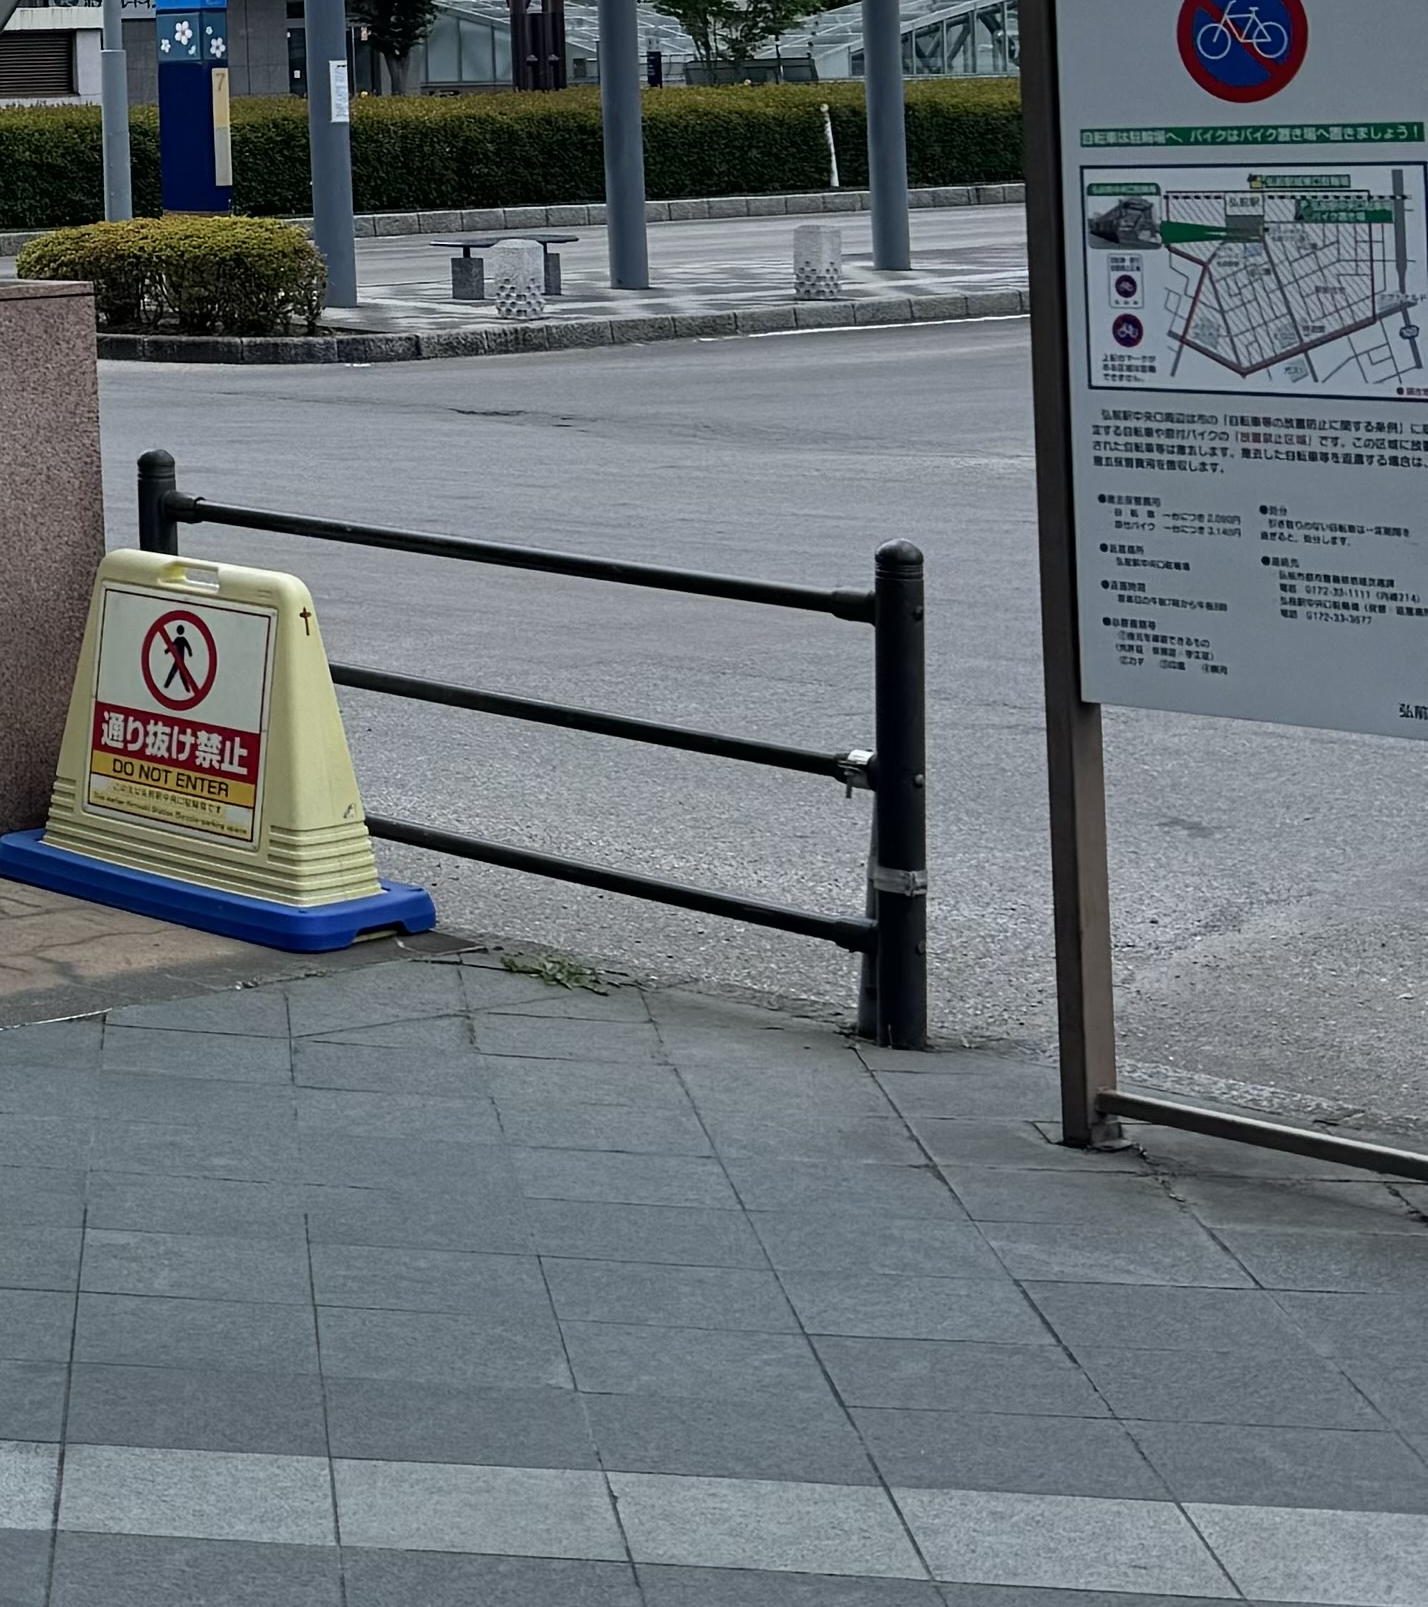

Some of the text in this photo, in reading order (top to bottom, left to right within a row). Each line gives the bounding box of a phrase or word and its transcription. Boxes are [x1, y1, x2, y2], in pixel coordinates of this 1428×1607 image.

[216, 73, 226, 91] 7
[101, 710, 248, 775] 通り抜け禁止
[113, 758, 229, 798] DO NOT ENTER
